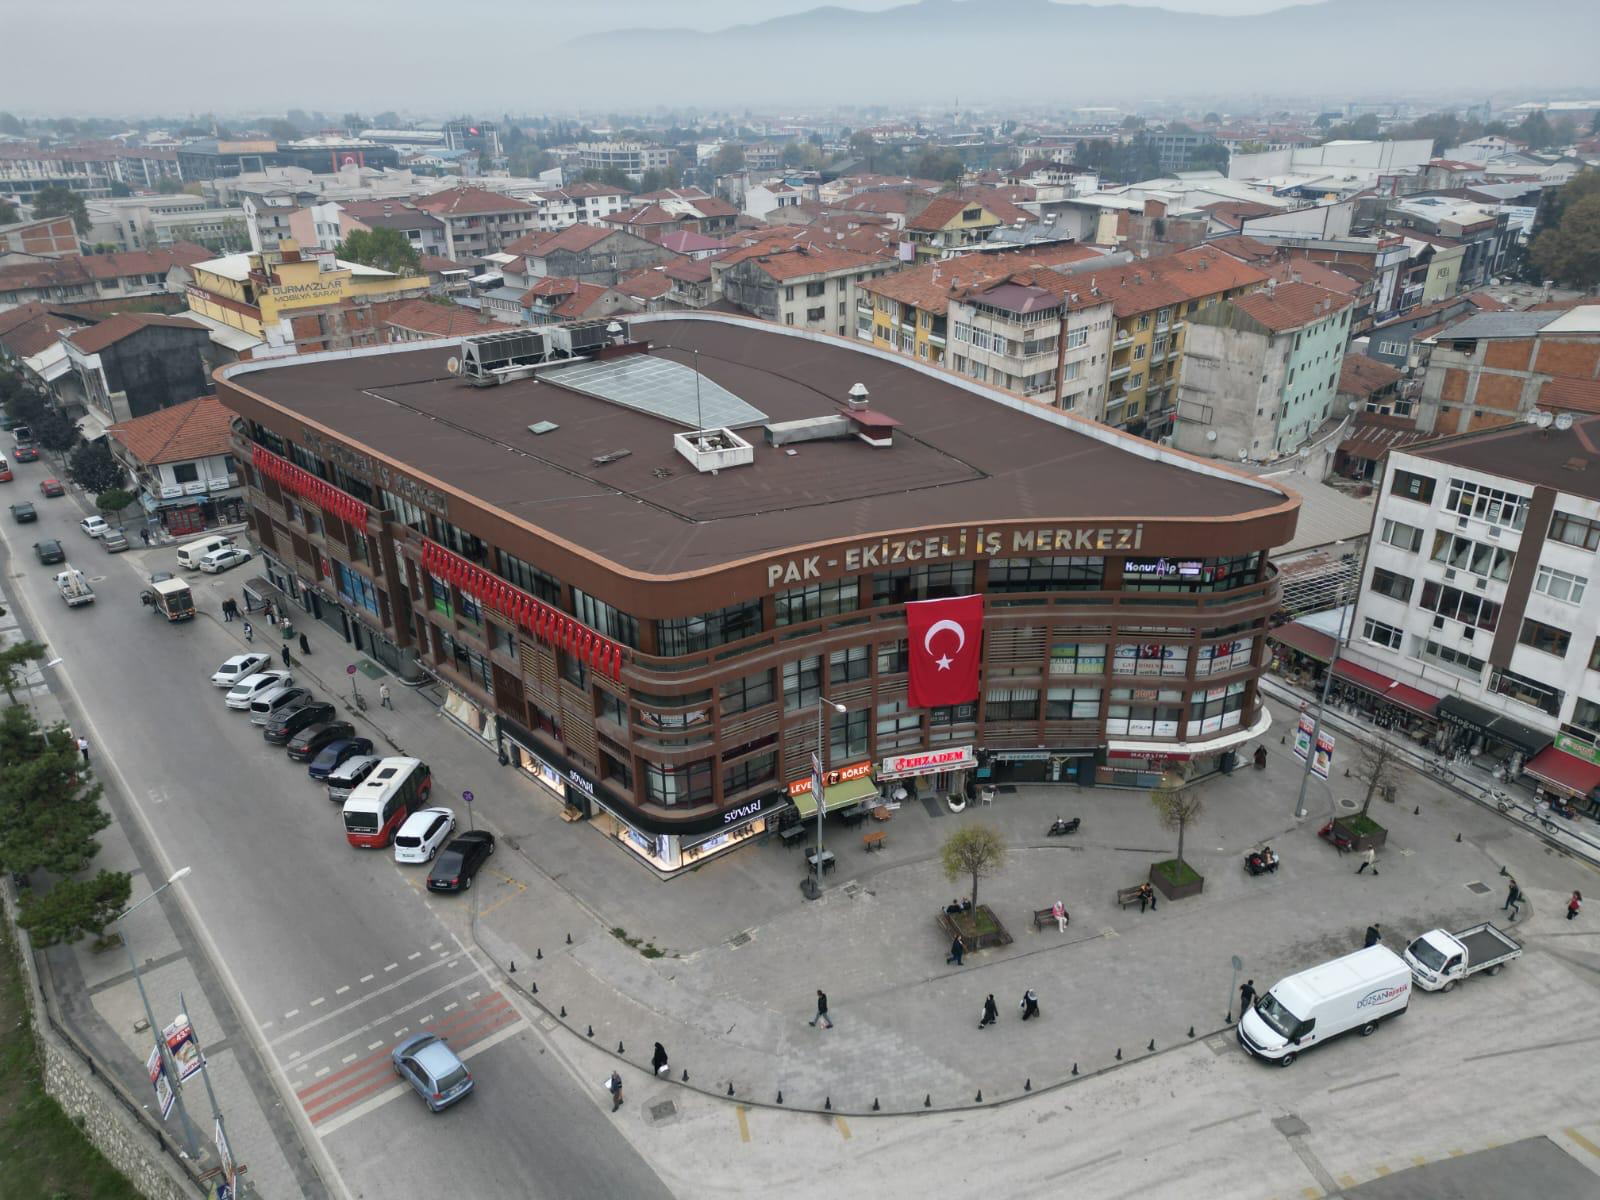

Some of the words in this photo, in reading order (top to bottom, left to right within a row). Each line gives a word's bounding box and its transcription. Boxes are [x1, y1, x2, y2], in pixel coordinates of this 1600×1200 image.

[272, 280, 342, 295] DURMAZLAR
[768, 555, 821, 588] PAK
[845, 528, 967, 572] EKİZCELİ
[976, 527, 1002, 555] İŞ
[1013, 523, 1143, 552] MERKEZİ
[842, 766, 870, 780] BÖREK
